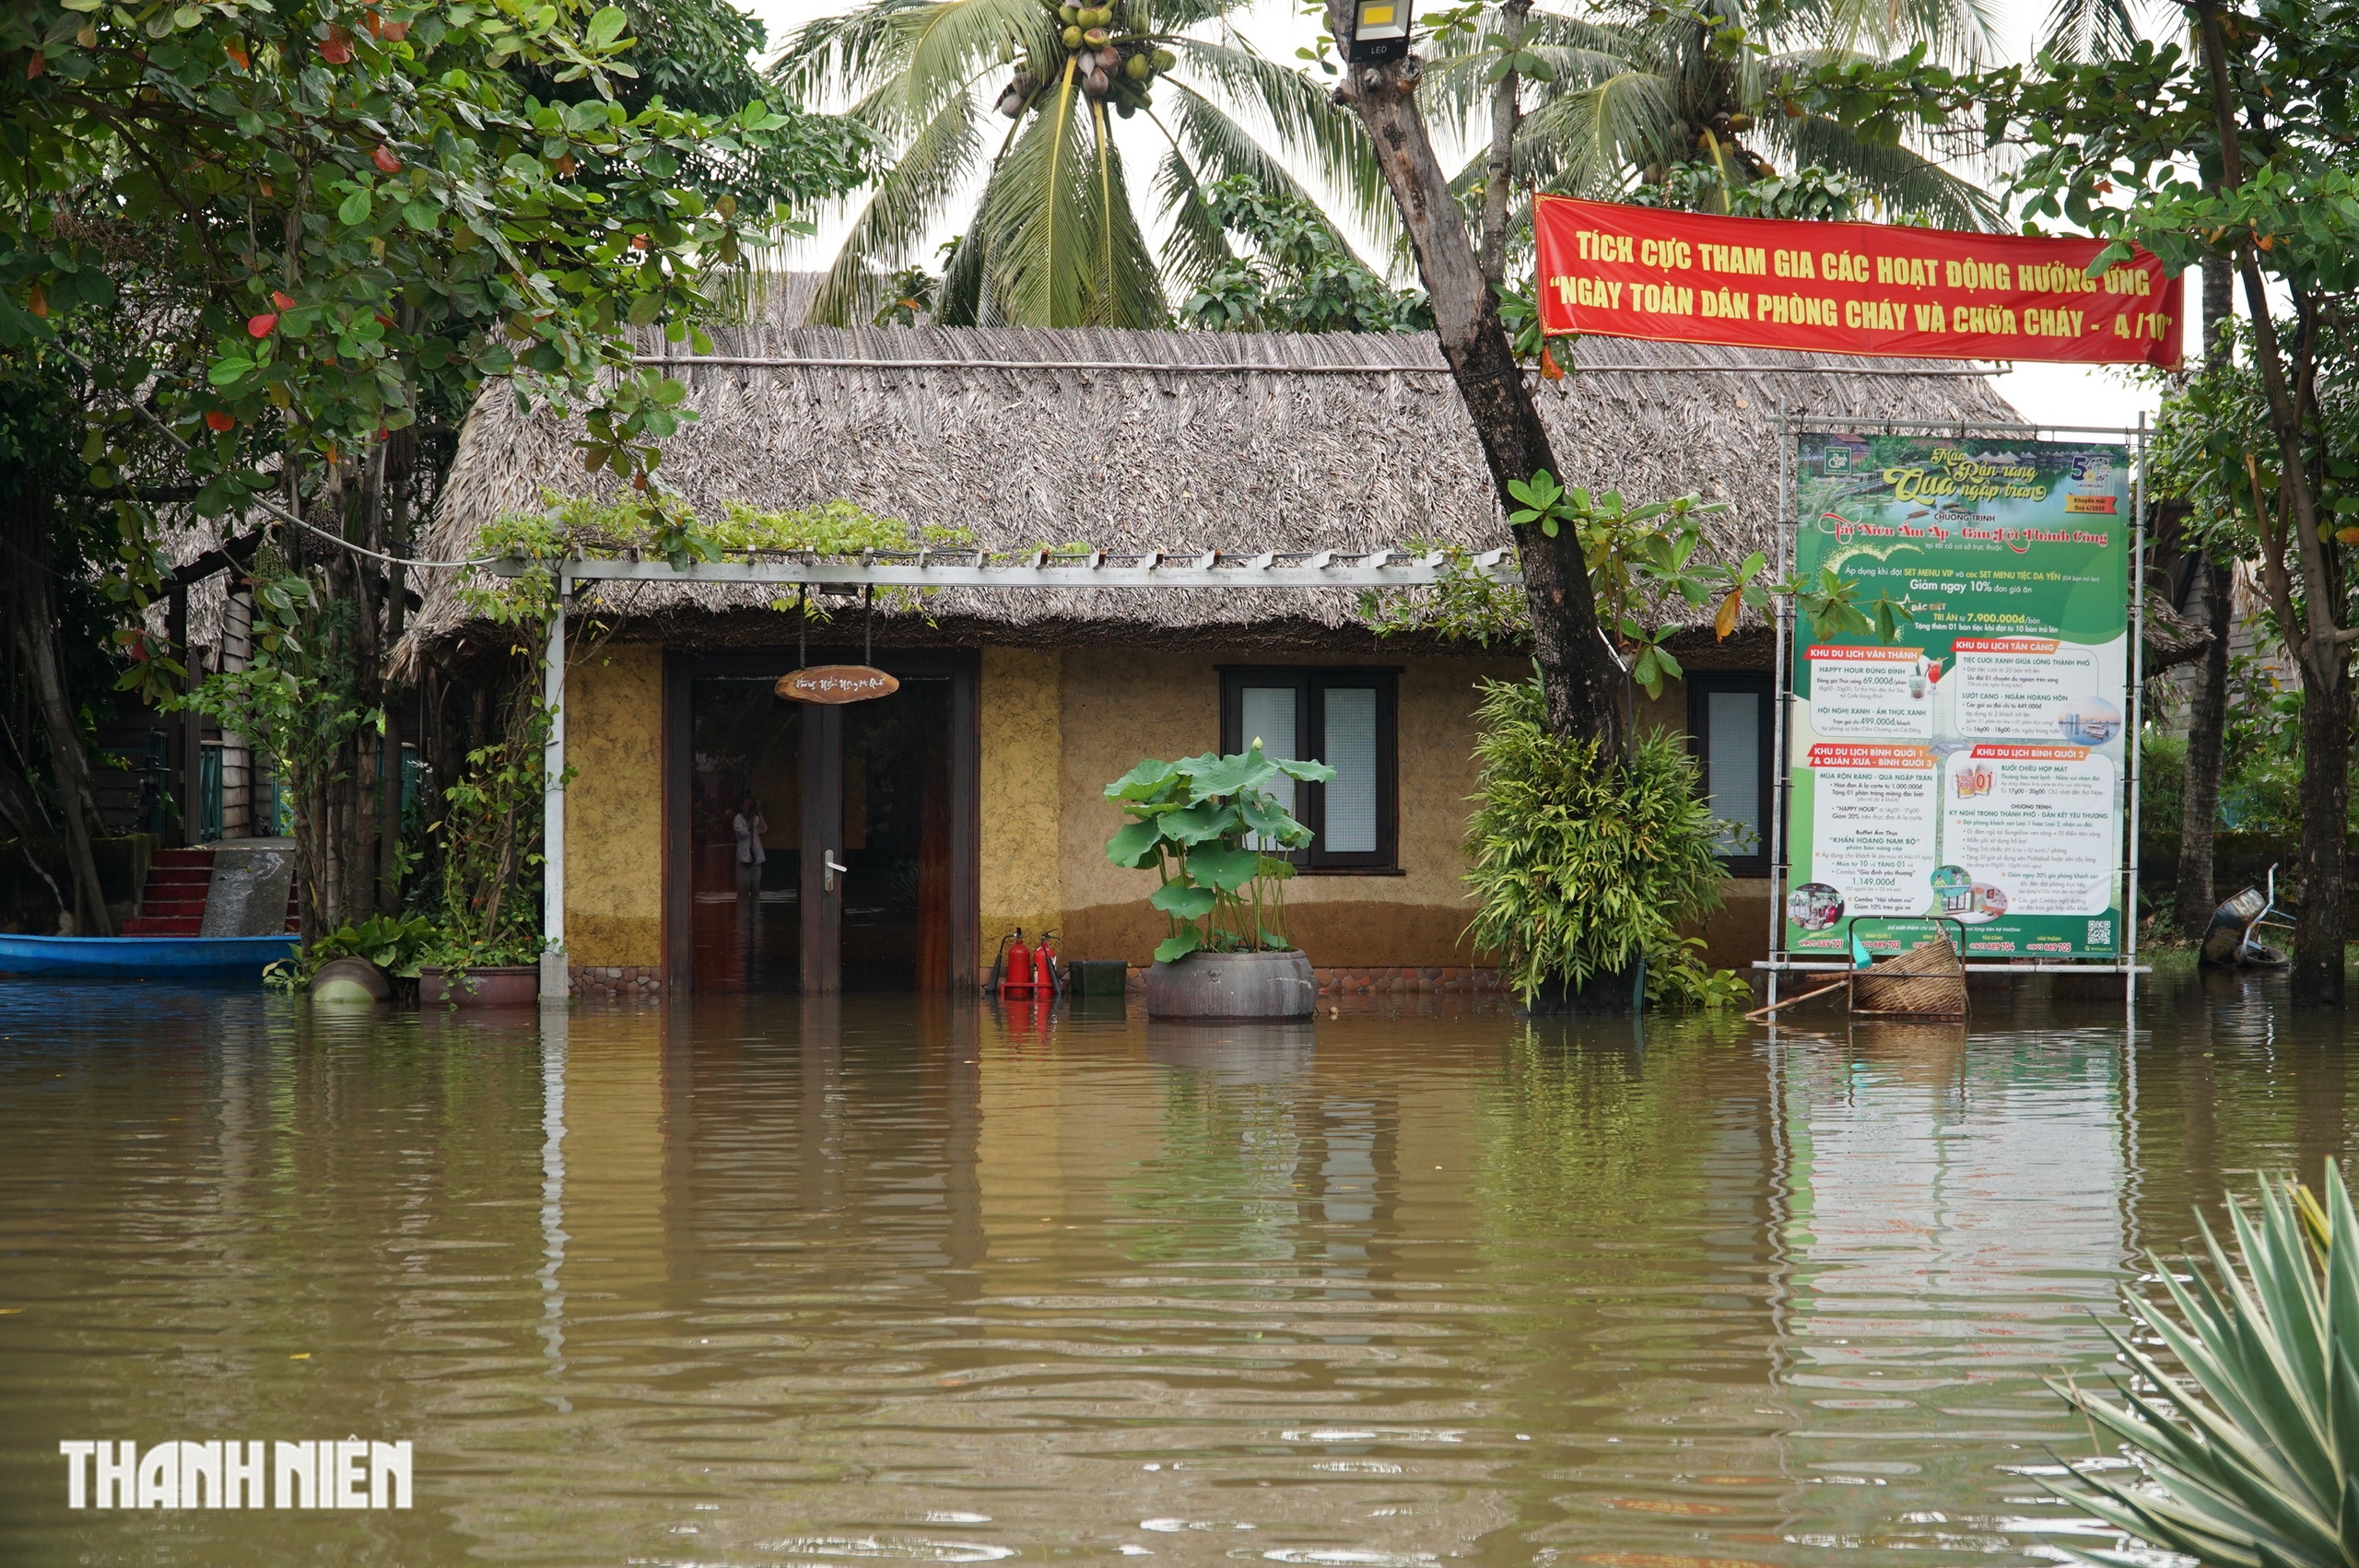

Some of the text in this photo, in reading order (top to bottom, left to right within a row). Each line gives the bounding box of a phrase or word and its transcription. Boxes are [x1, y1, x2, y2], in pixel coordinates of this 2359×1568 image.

[1371, 45, 1388, 54] LED
[1577, 229, 2150, 296] TÍCH CỰC THAM GIA CÁC HOẠT ĐỘNG HƯỞNG ỨNG
[1629, 282, 1693, 315] TOÀN
[1702, 287, 1749, 320] DÂN
[1757, 293, 1838, 328] PHÒNG
[1846, 298, 1907, 331] CHÁY
[1914, 301, 1946, 333] VÀ
[1954, 304, 2017, 334] CHỮA
[2024, 307, 2083, 337] CHÁY
[1931, 448, 1966, 467] Mùa
[2001, 461, 2037, 484] ràng
[1883, 467, 1958, 506] Quà
[1960, 481, 2047, 503] ngập tràn
[1857, 523, 1895, 537] Niên
[2022, 529, 2071, 542] Thành
[2073, 530, 2108, 547] Công
[1845, 565, 1856, 576] Áp
[1858, 567, 1875, 577] dụng
[1890, 568, 1902, 577] đặt
[2017, 570, 2032, 580] TIỆC
[2033, 572, 2044, 581] DẠ
[2046, 571, 2060, 580] YẾN
[1909, 579, 1937, 590] Giảm
[1941, 582, 1966, 593] ngay
[1970, 580, 1992, 592] 10%
[1994, 584, 2007, 592] đơn
[2009, 585, 2021, 594] giá
[1911, 603, 1946, 613] ĐẶC BIỆT
[1933, 613, 1943, 621] TRI
[1945, 613, 1958, 622] ÂN
[1915, 622, 1931, 631] Tặng
[1956, 641, 1975, 649] KHU
[1990, 642, 2009, 652] LỊCH
[2011, 641, 2028, 650] TÂN
[2030, 641, 2055, 651] CẢNG
[1846, 650, 1864, 659] LỊCH
[1867, 649, 1885, 658] VĂN
[1887, 650, 1918, 659] THÁNH
[1850, 749, 1868, 757] LỊCH
[1871, 747, 1890, 756] BÌNH
[1893, 748, 1916, 757] QUỚI
[2012, 749, 2029, 758] LỊCH
[2032, 748, 2052, 757] BÌNH
[2054, 749, 2076, 758] QUỚI
[1824, 756, 1849, 766] QUÁN
[1852, 757, 1871, 766] XƯA
[1879, 757, 1900, 766] BÌNH
[1902, 757, 1924, 766] QUỚI
[1976, 774, 1992, 789] 01
[1852, 877, 1895, 885] 1.149.000đ
[1817, 940, 1831, 948] 889
[1831, 940, 1844, 949] 701
[1873, 941, 1888, 949] 889
[1889, 940, 1901, 950] 702
[1987, 942, 2001, 951] 889
[2001, 942, 2015, 952] 704
[2044, 943, 2058, 952] 889
[2059, 942, 2071, 953] 705
